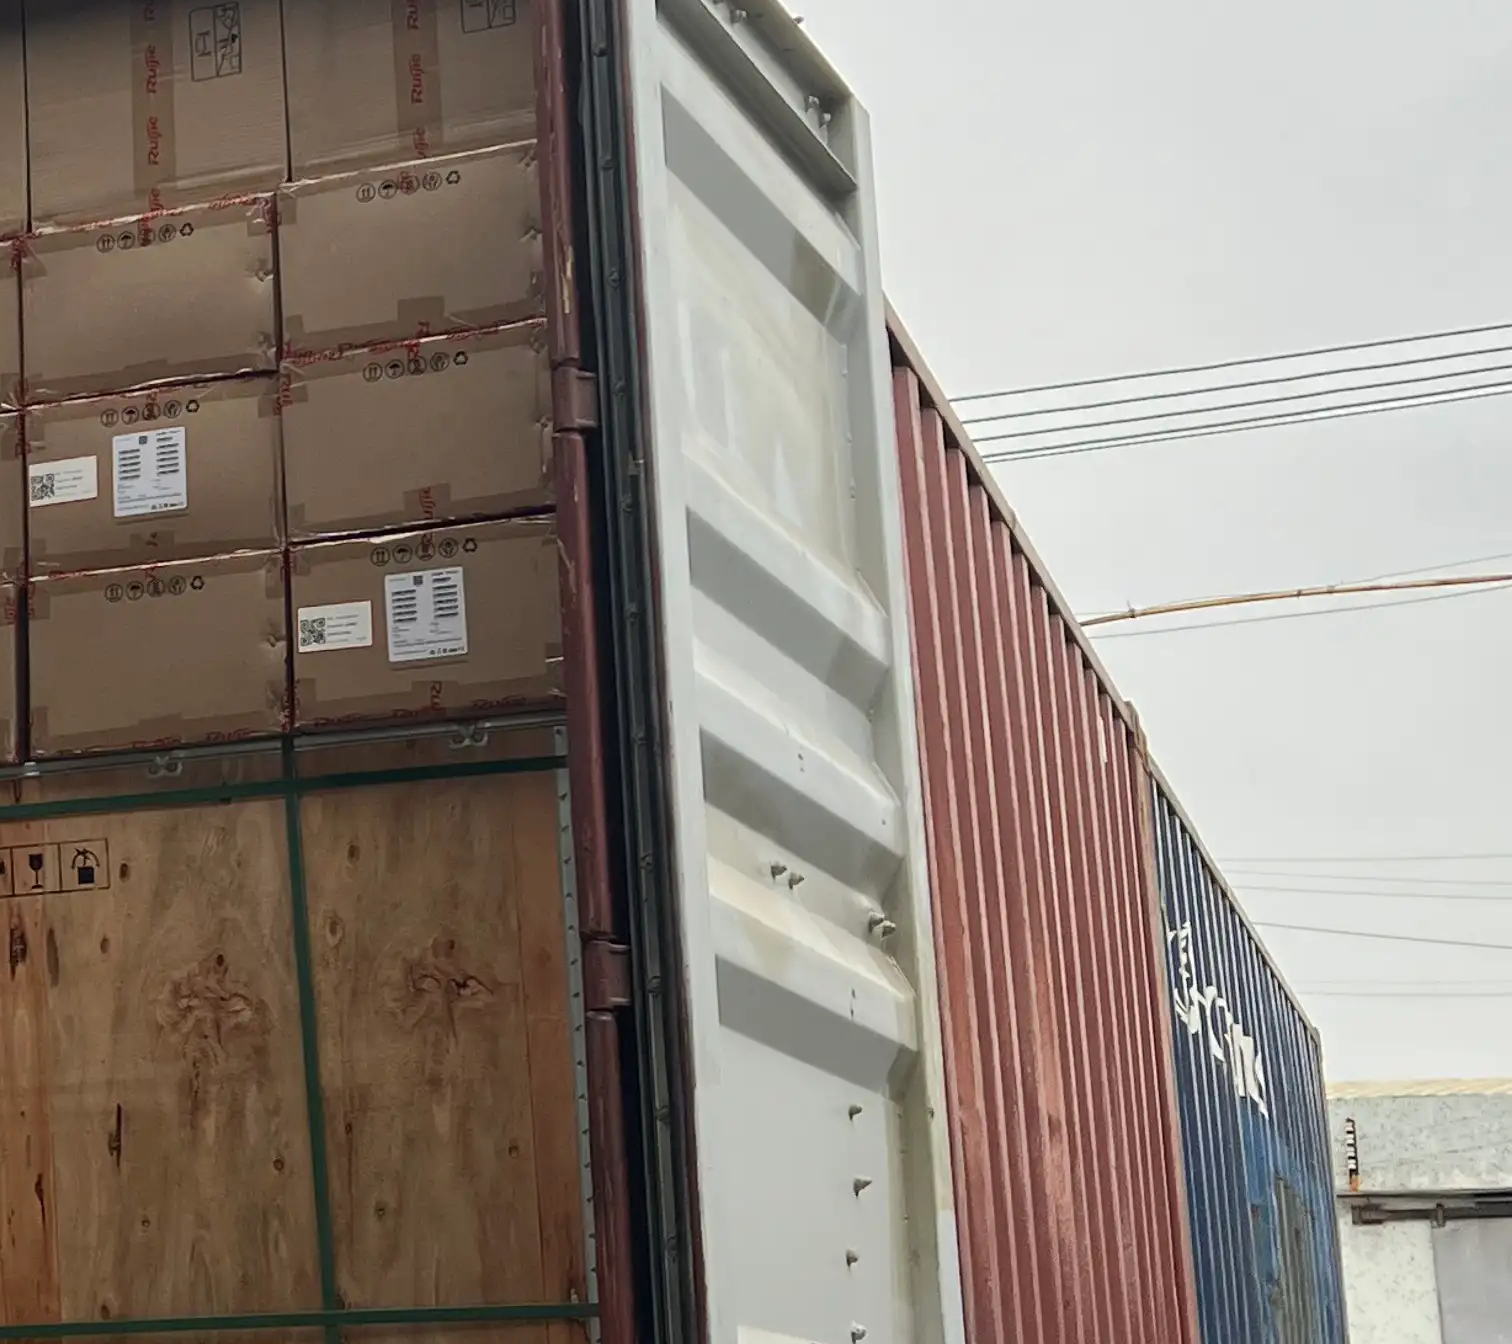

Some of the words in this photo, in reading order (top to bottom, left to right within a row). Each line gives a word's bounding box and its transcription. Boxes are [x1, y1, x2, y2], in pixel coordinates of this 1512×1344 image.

[144, 44, 161, 94] Ruijie
[408, 53, 426, 104] Ruijie
[147, 116, 163, 166] Ruijie
